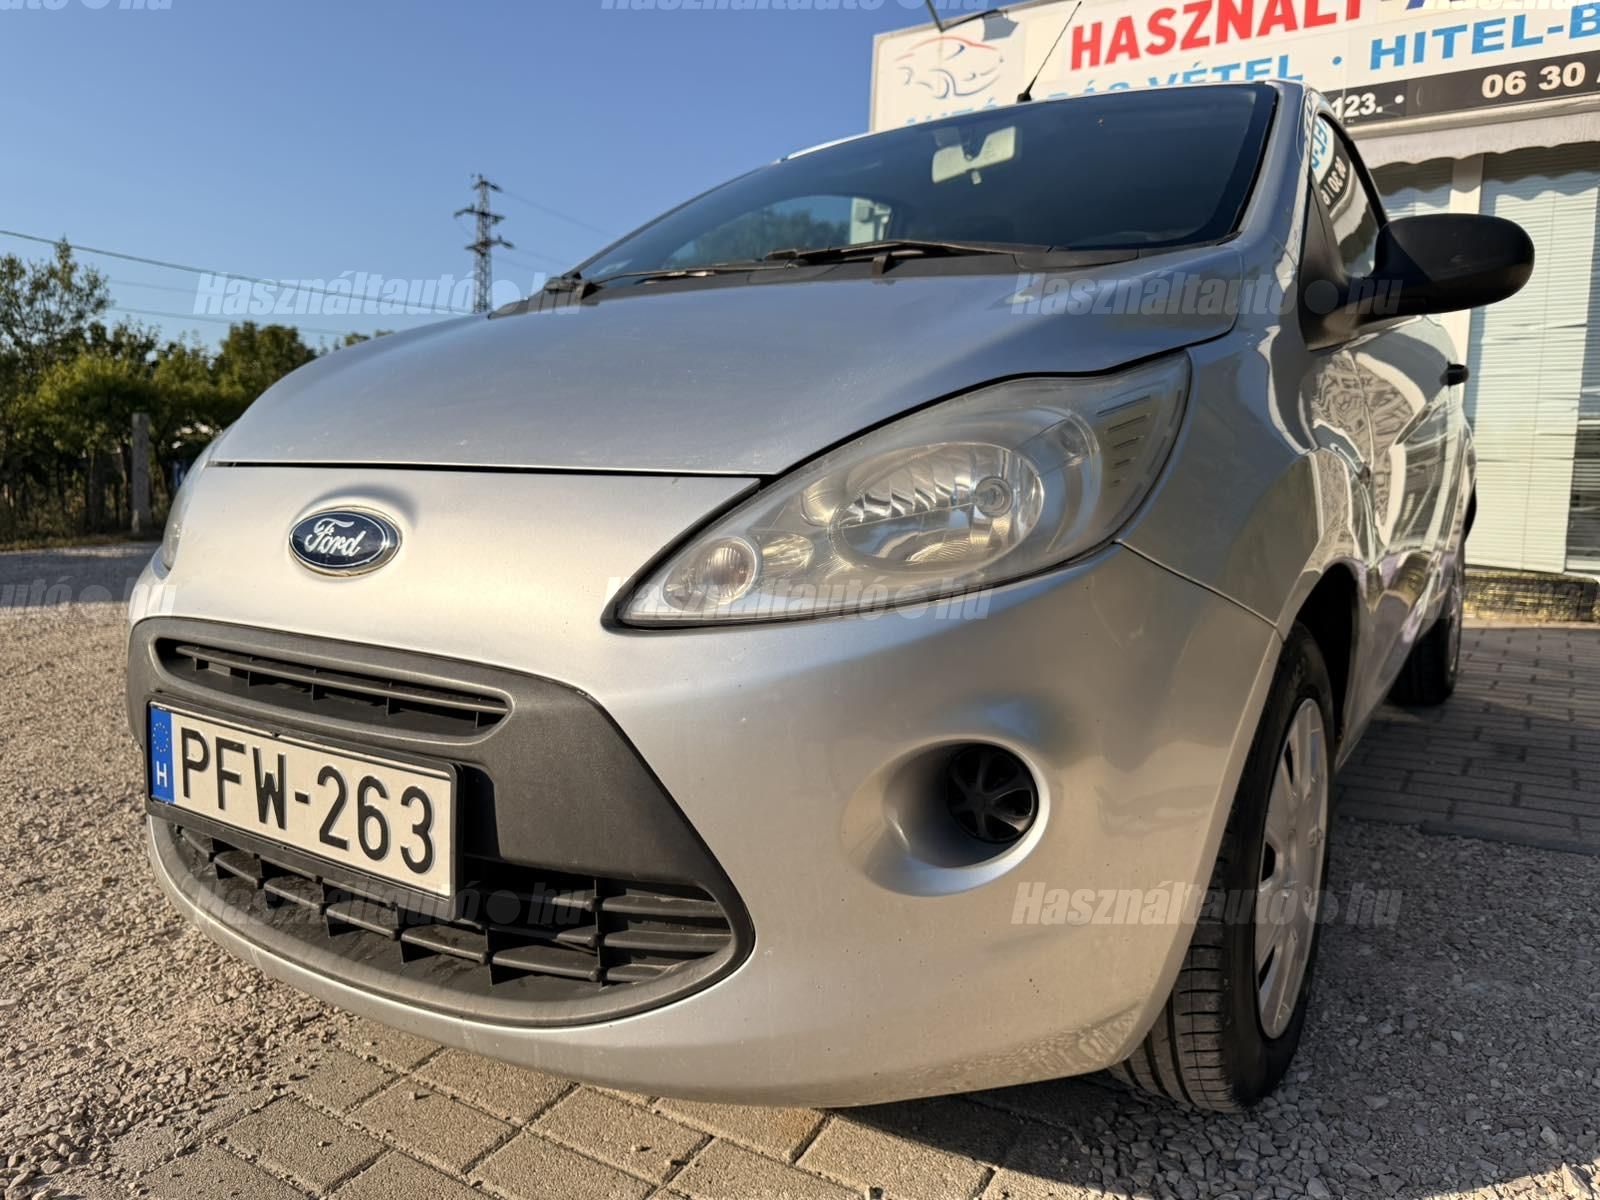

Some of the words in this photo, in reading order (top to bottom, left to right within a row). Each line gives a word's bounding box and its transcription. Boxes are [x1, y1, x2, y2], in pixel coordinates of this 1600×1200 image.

[1481, 70, 1527, 99] 06
[1538, 61, 1586, 91] 30
[304, 518, 366, 557] Ford
[156, 760, 168, 787] H
[180, 727, 434, 874] PFW-263
